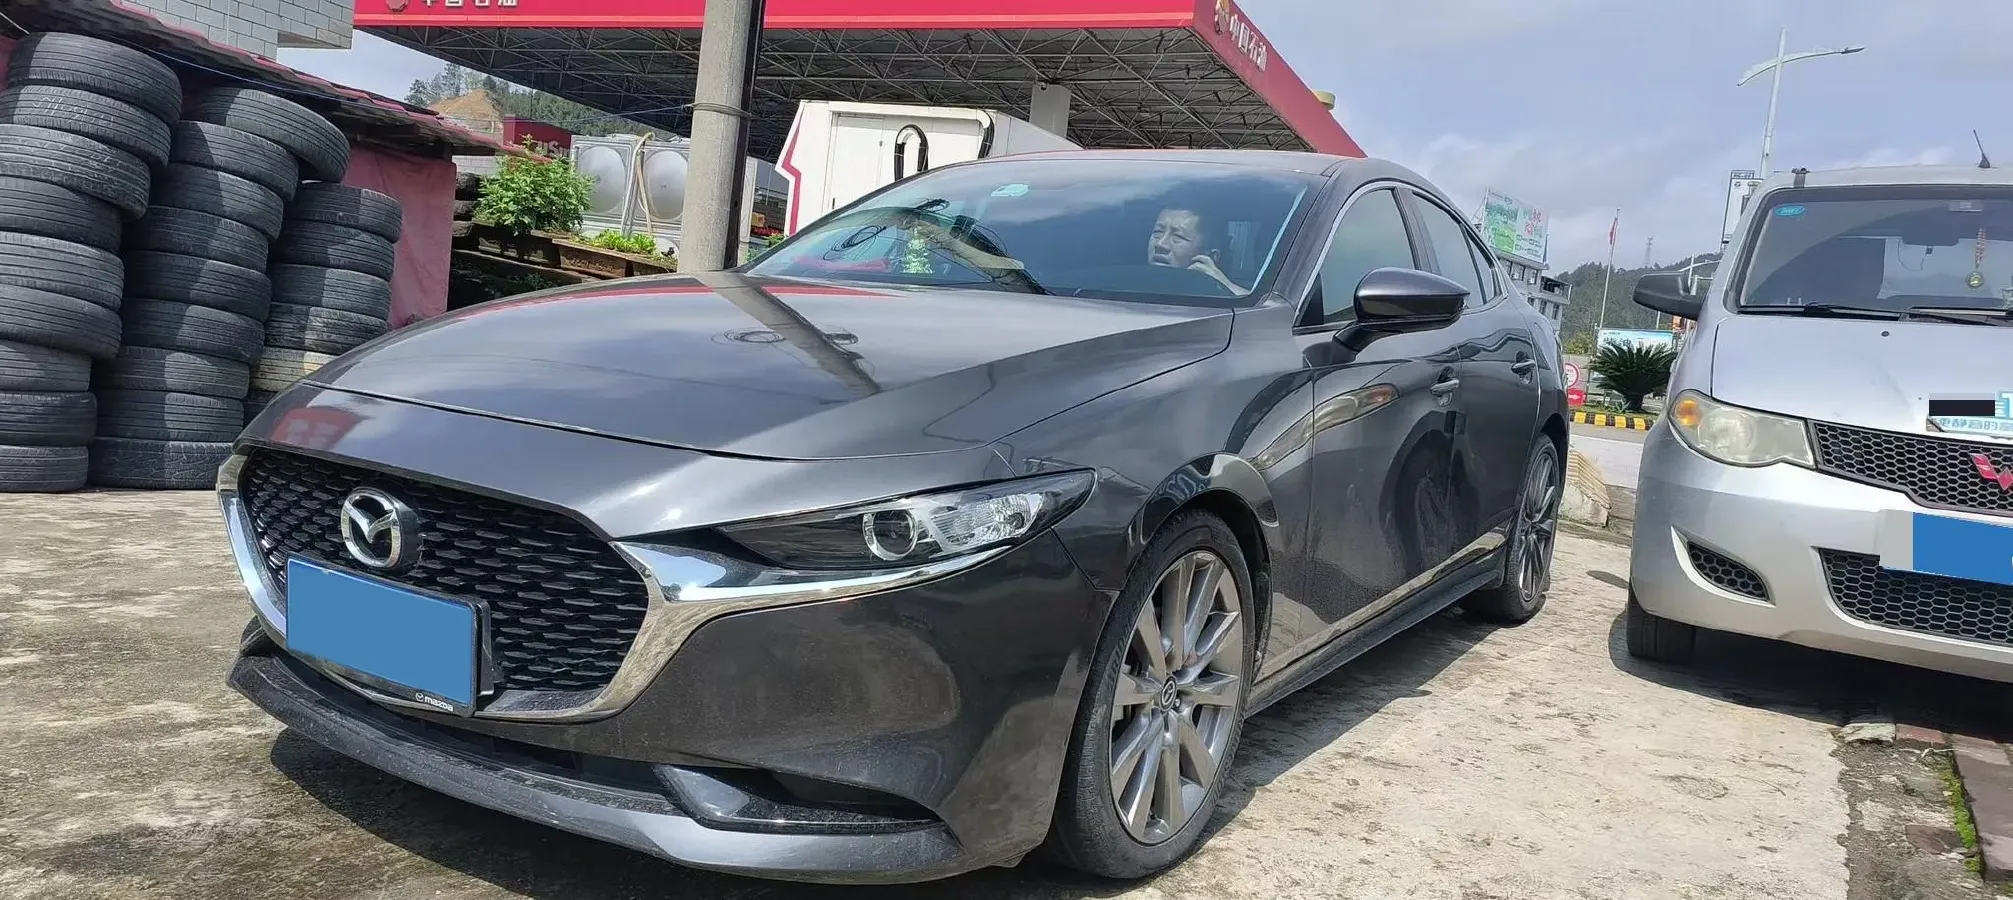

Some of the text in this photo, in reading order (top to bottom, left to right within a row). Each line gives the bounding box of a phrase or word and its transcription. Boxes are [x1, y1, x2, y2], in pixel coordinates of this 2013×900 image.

[1229, 13, 1268, 72] 中国石油
[424, 696, 454, 712] mazda
